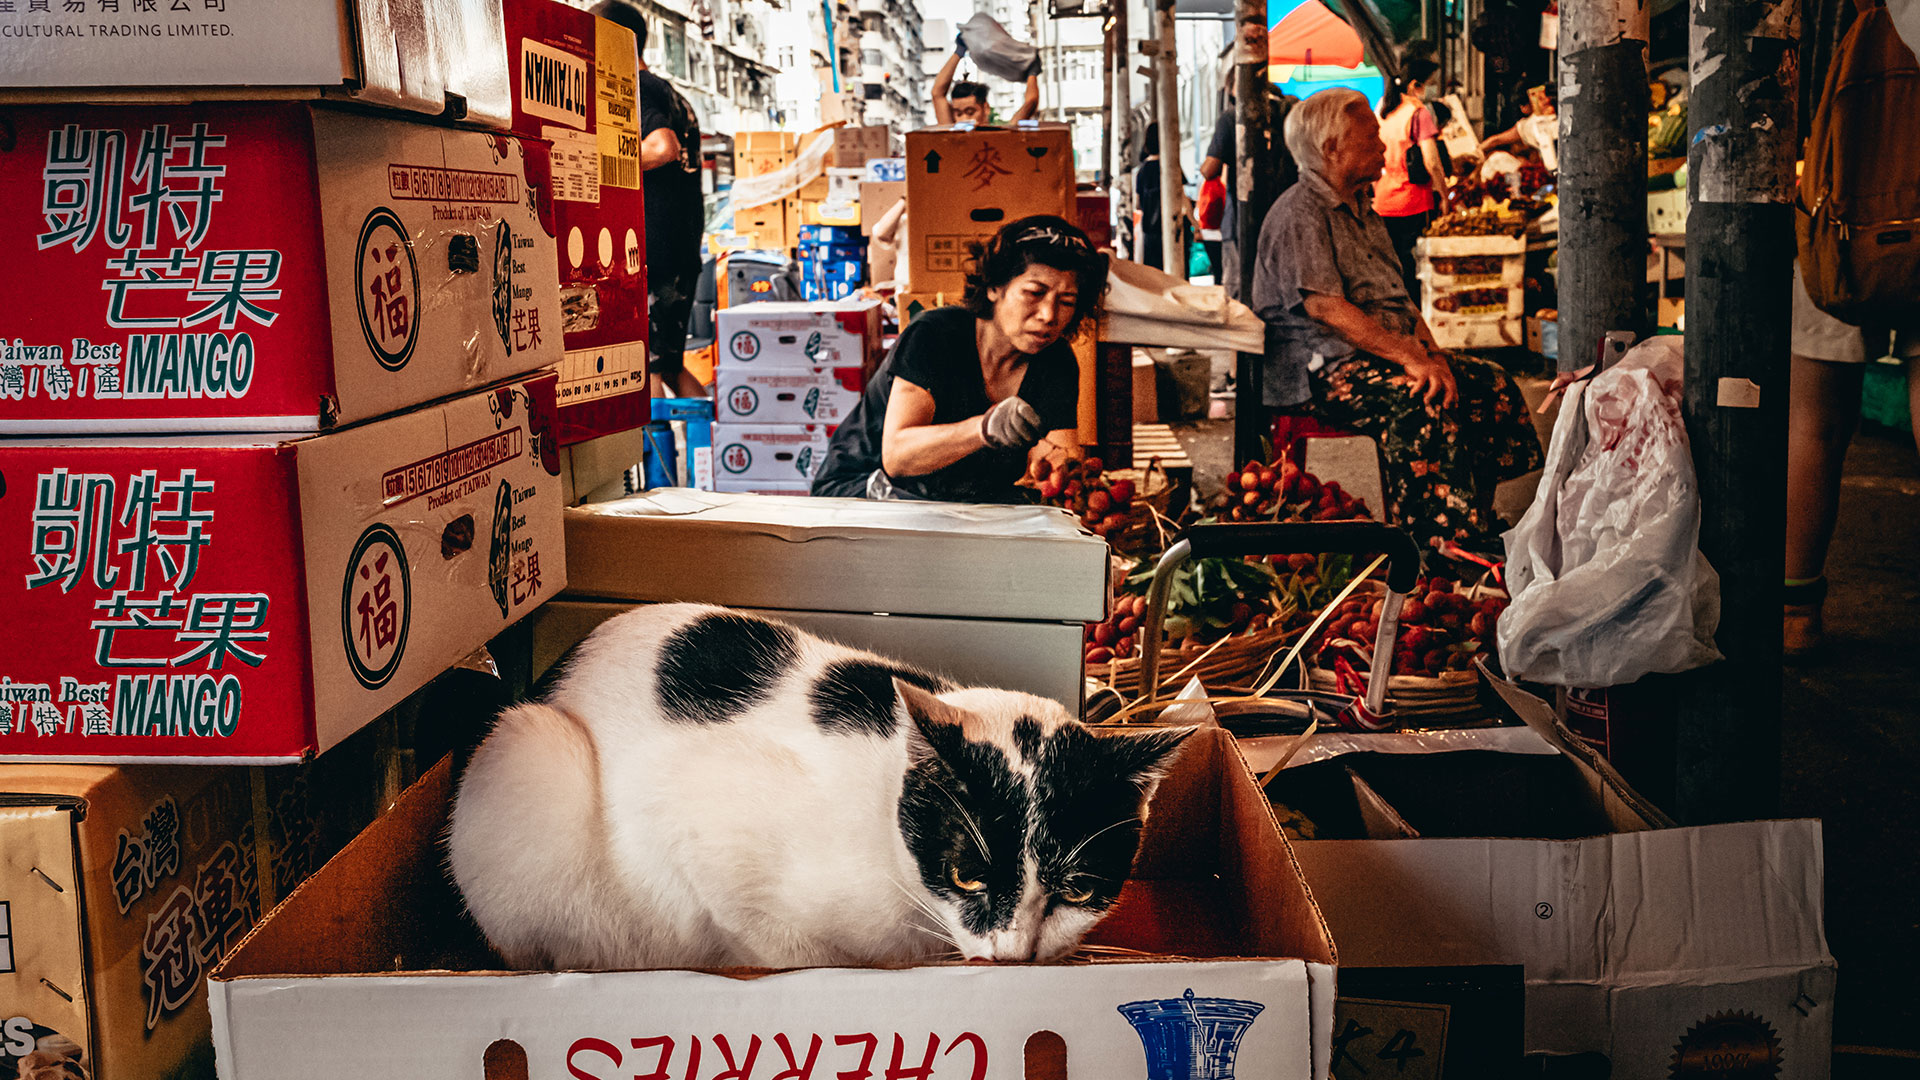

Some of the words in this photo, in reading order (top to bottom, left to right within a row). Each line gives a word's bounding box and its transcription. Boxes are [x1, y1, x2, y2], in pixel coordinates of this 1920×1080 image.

[2, 24, 84, 37] CULTURAL
[89, 24, 161, 37] TRADING
[167, 24, 234, 37] LIMITED.
[525, 50, 572, 110] TAIWAN
[574, 67, 586, 118] TO
[618, 134, 638, 158] 30421
[963, 142, 1014, 192] 麥
[37, 123, 228, 253] 凱特
[433, 205, 457, 221] Product
[458, 206, 465, 220] of
[465, 206, 493, 221] TAIWAN
[512, 233, 535, 249] Taiwan
[512, 260, 527, 274] Best
[101, 249, 284, 330] 芒果
[370, 242, 410, 343] 福
[512, 286, 533, 302] Mango
[75, 339, 121, 361] Best
[513, 307, 542, 353] 芒果
[126, 332, 255, 396] MANGO
[613, 379, 619, 388] 56
[622, 377, 628, 386] 48
[630, 370, 642, 384] Size
[562, 388, 572, 397] 100
[584, 384, 591, 393] 80
[595, 382, 601, 391] 72
[443, 457, 449, 482] 9
[502, 435, 508, 457] B
[427, 488, 454, 511] Product
[454, 484, 462, 497] of
[462, 470, 492, 495] TAIWAN
[512, 485, 536, 505] Taiwan
[26, 467, 215, 593] 凱特
[511, 514, 527, 532] Best
[511, 551, 542, 607] 芒果
[357, 551, 397, 660] 福
[90, 590, 270, 671] 芒果
[64, 682, 110, 703] Best
[115, 676, 243, 738] MANGO
[110, 794, 180, 916] 台灣
[565, 1032, 989, 1080] CHERRIES
